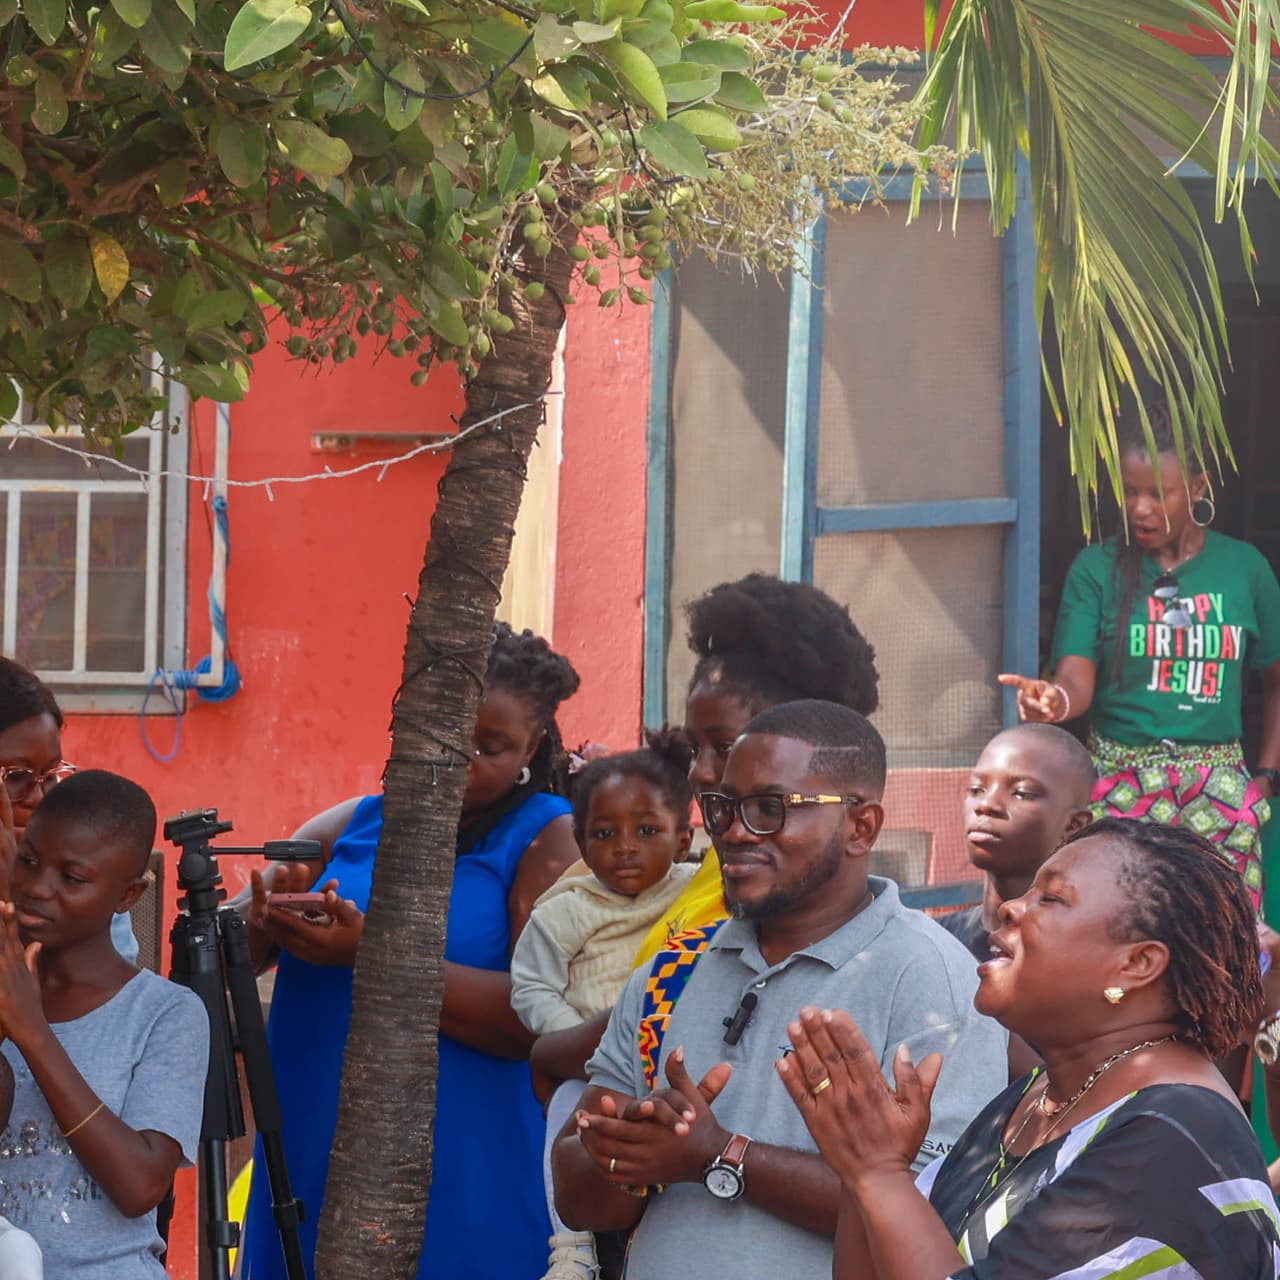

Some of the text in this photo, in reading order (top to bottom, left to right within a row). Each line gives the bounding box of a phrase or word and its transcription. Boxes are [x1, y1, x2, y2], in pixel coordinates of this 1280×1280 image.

[1147, 593, 1224, 623] HPY
[1130, 623, 1242, 660] BIRTHDAY
[1146, 659, 1225, 697] JESUS!
